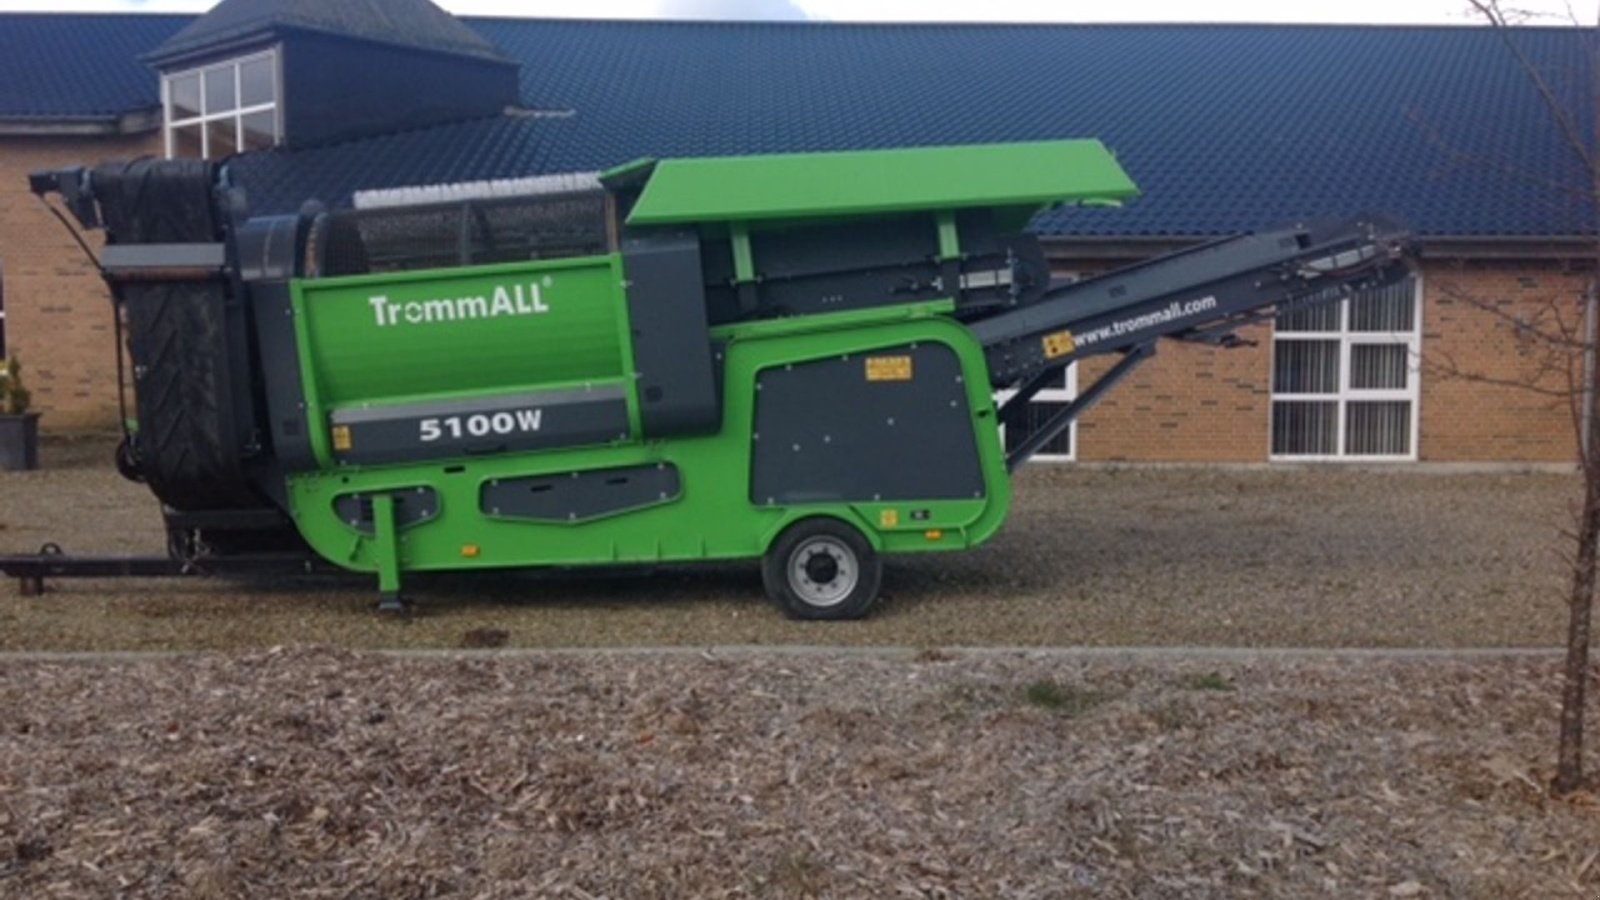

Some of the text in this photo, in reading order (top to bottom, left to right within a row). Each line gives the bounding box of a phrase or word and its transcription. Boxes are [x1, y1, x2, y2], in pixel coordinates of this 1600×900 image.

[369, 283, 549, 326] TrommALL
[1074, 295, 1217, 347] www.trommall.com
[419, 409, 542, 441] 5100W
